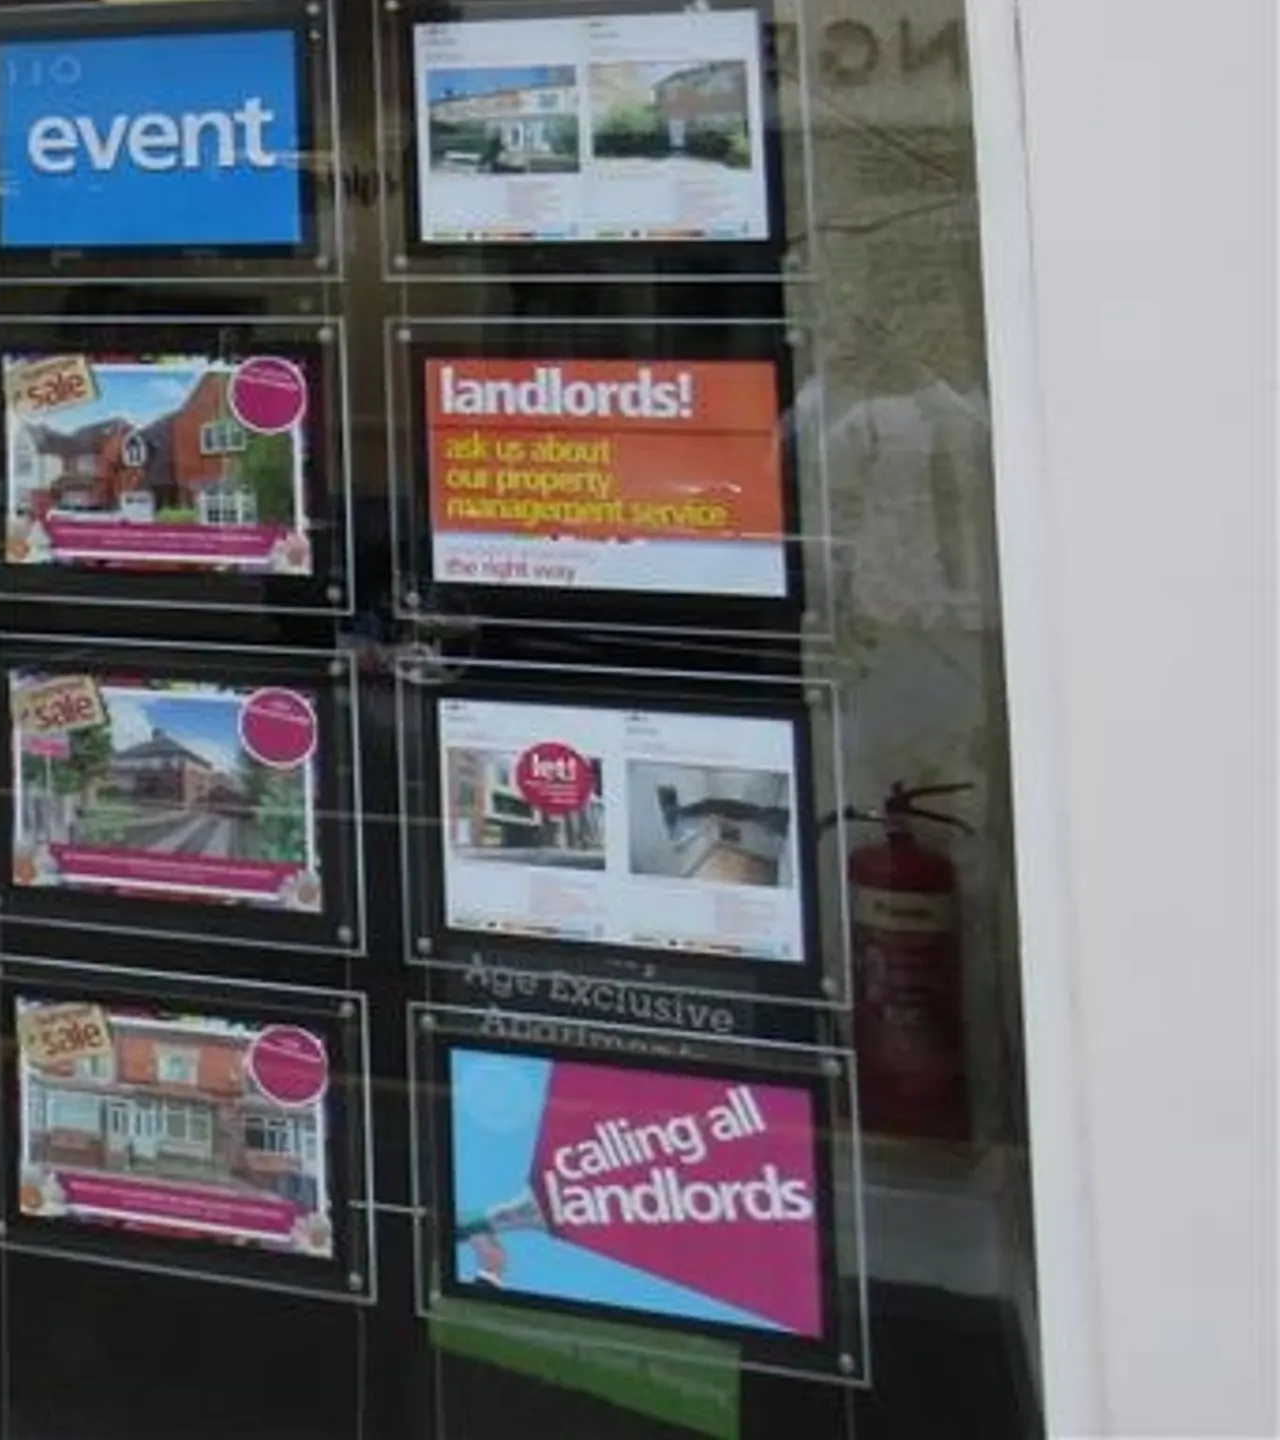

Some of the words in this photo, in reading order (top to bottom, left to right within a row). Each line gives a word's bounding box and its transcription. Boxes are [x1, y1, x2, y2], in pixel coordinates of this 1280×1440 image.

[27, 96, 277, 174] event
[439, 366, 694, 419] landlords!
[445, 432, 486, 461] ask
[496, 439, 526, 462] us
[530, 433, 612, 463] about
[445, 468, 488, 489] our
[497, 466, 613, 498] property
[446, 500, 623, 527] management
[632, 503, 729, 527] service
[482, 550, 529, 583] right
[532, 563, 577, 584] way
[33, 690, 95, 729] sale
[465, 952, 539, 1000] Age
[549, 971, 735, 1033] Exclusive
[38, 1018, 102, 1059] sale
[554, 1114, 705, 1180] calling
[707, 1085, 766, 1143] all
[545, 1165, 813, 1226] landlords
